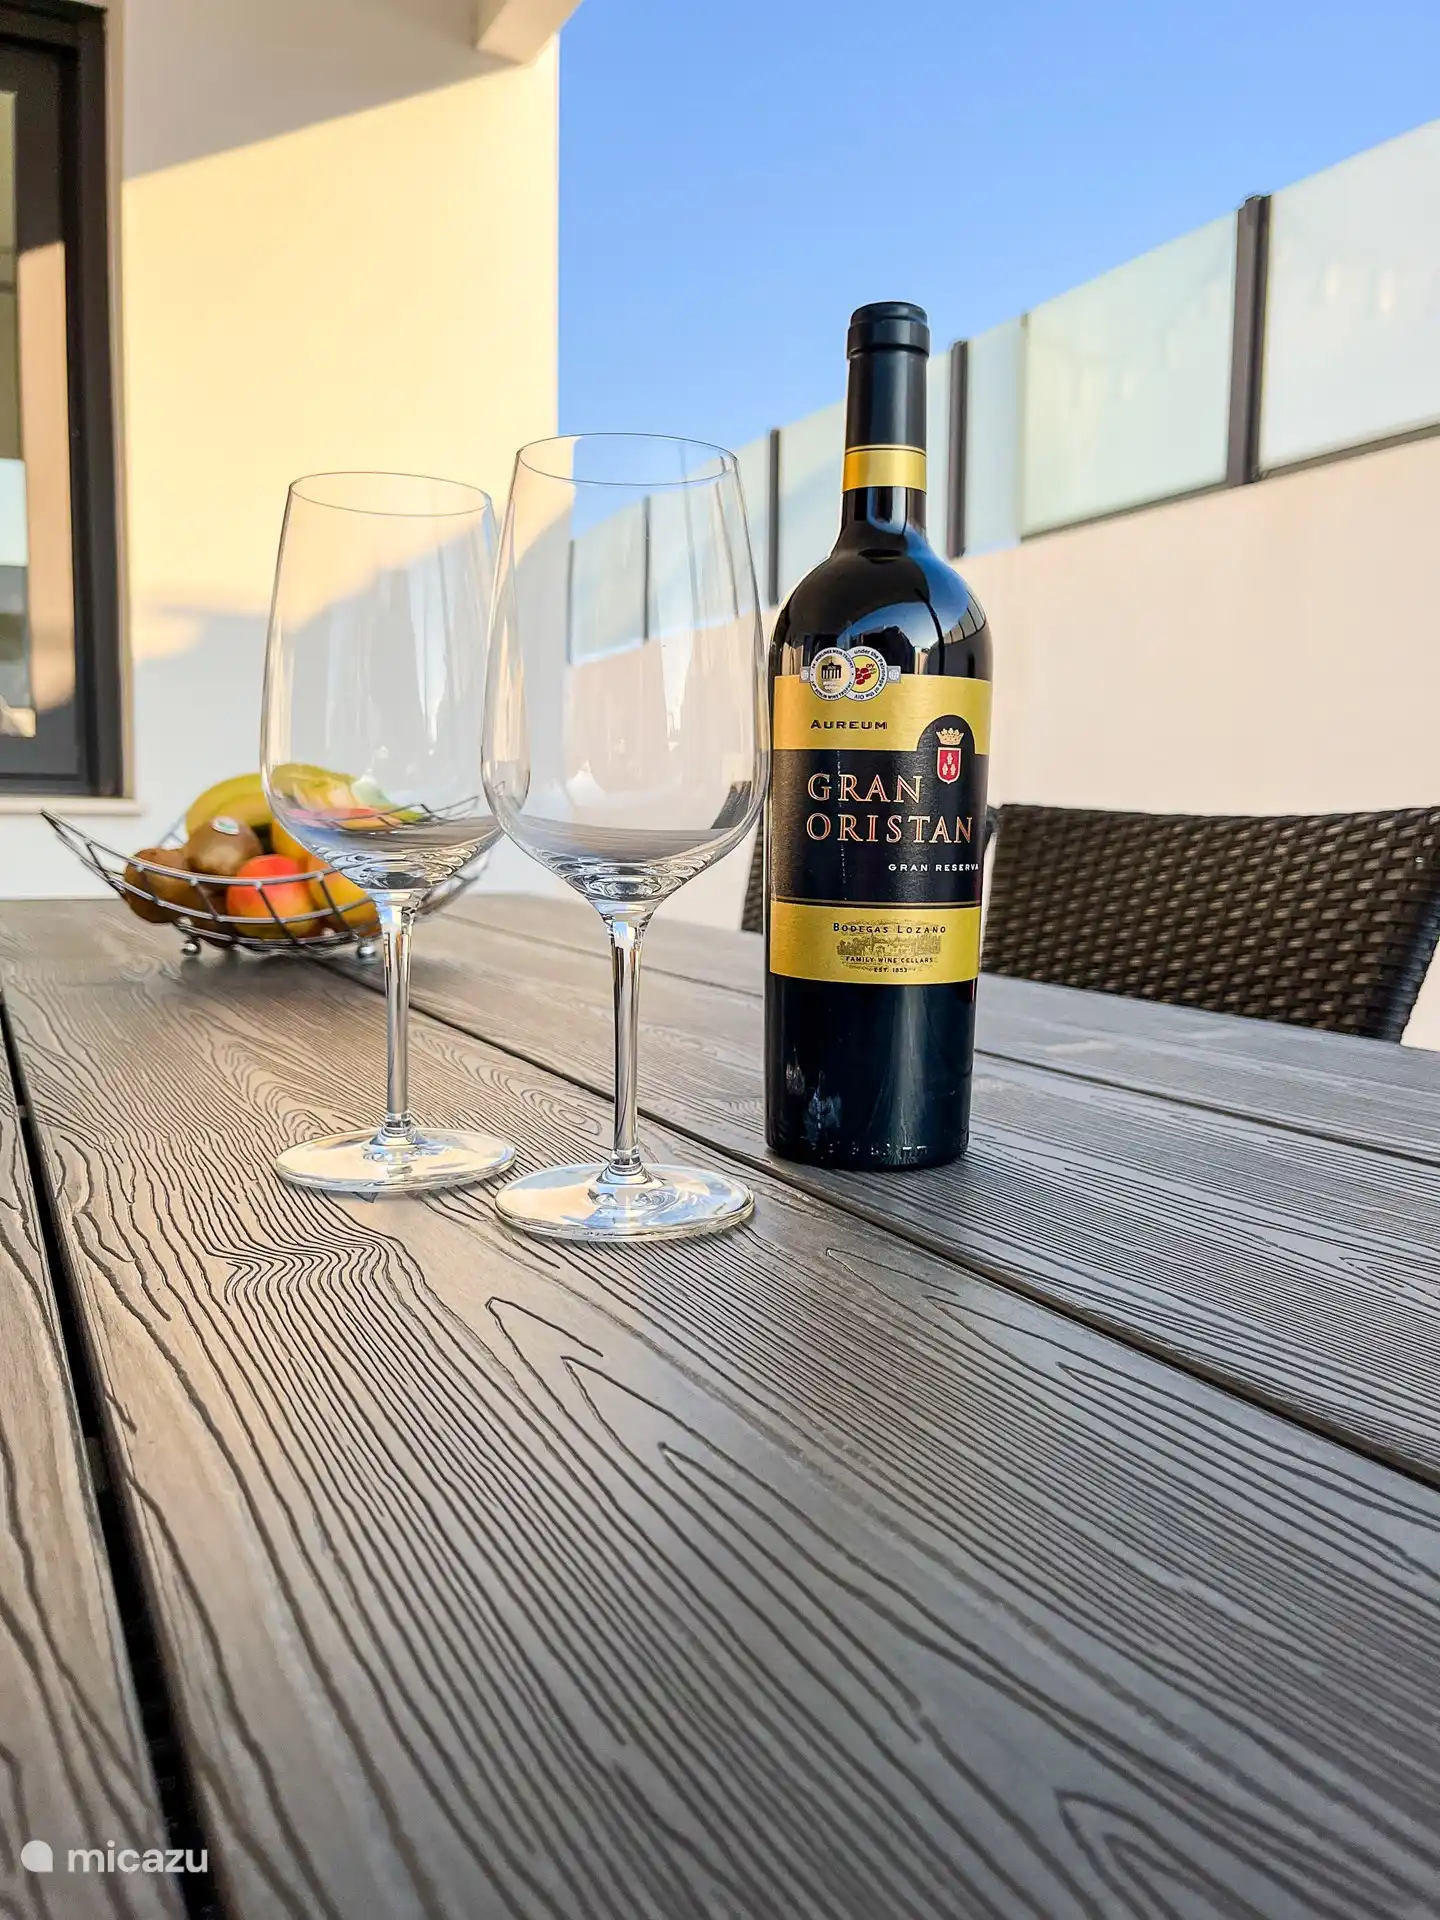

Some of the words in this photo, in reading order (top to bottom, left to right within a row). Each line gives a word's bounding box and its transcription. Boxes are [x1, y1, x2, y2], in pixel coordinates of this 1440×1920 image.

[870, 651, 879, 659] the
[807, 772, 923, 804] GRAN
[806, 812, 973, 844] ORISTAN
[888, 863, 928, 872] GRAN
[935, 863, 979, 872] RESERVA
